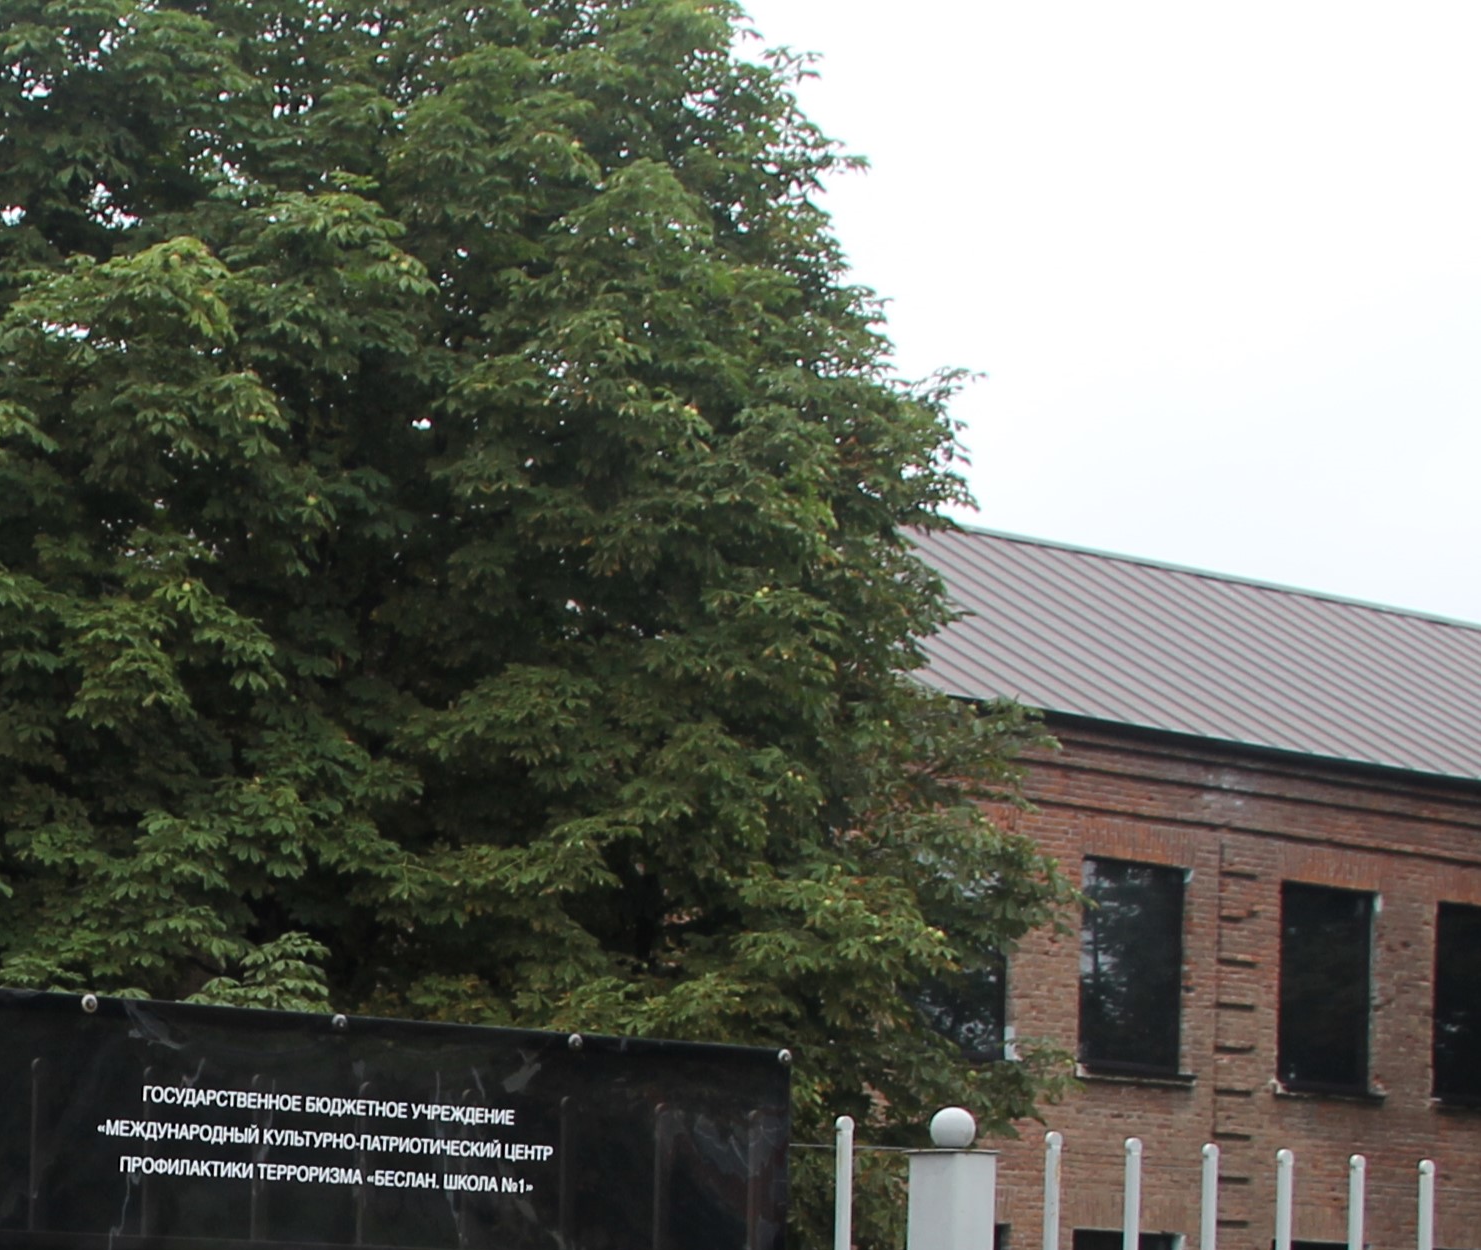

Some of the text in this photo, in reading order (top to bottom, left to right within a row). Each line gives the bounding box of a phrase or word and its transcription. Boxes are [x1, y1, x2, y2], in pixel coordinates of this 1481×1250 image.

[142, 1085, 515, 1126] ГОСУДАРСТВЕННОЕ БЮДЖЕТНОЕ УЧРЕЖДЕНИЕ
[97, 1119, 554, 1162] «МЕЖДУНАРОДНЫЙ КУЛЬТУРНО-ПАТРИОТИЧЕСКИЙ ЦЕНТР
[119, 1156, 535, 1194] ПРОФИЛАКТИКИ ТЕРРОРИЗМА «БЕСЛАН. ШКОЛА №1»
